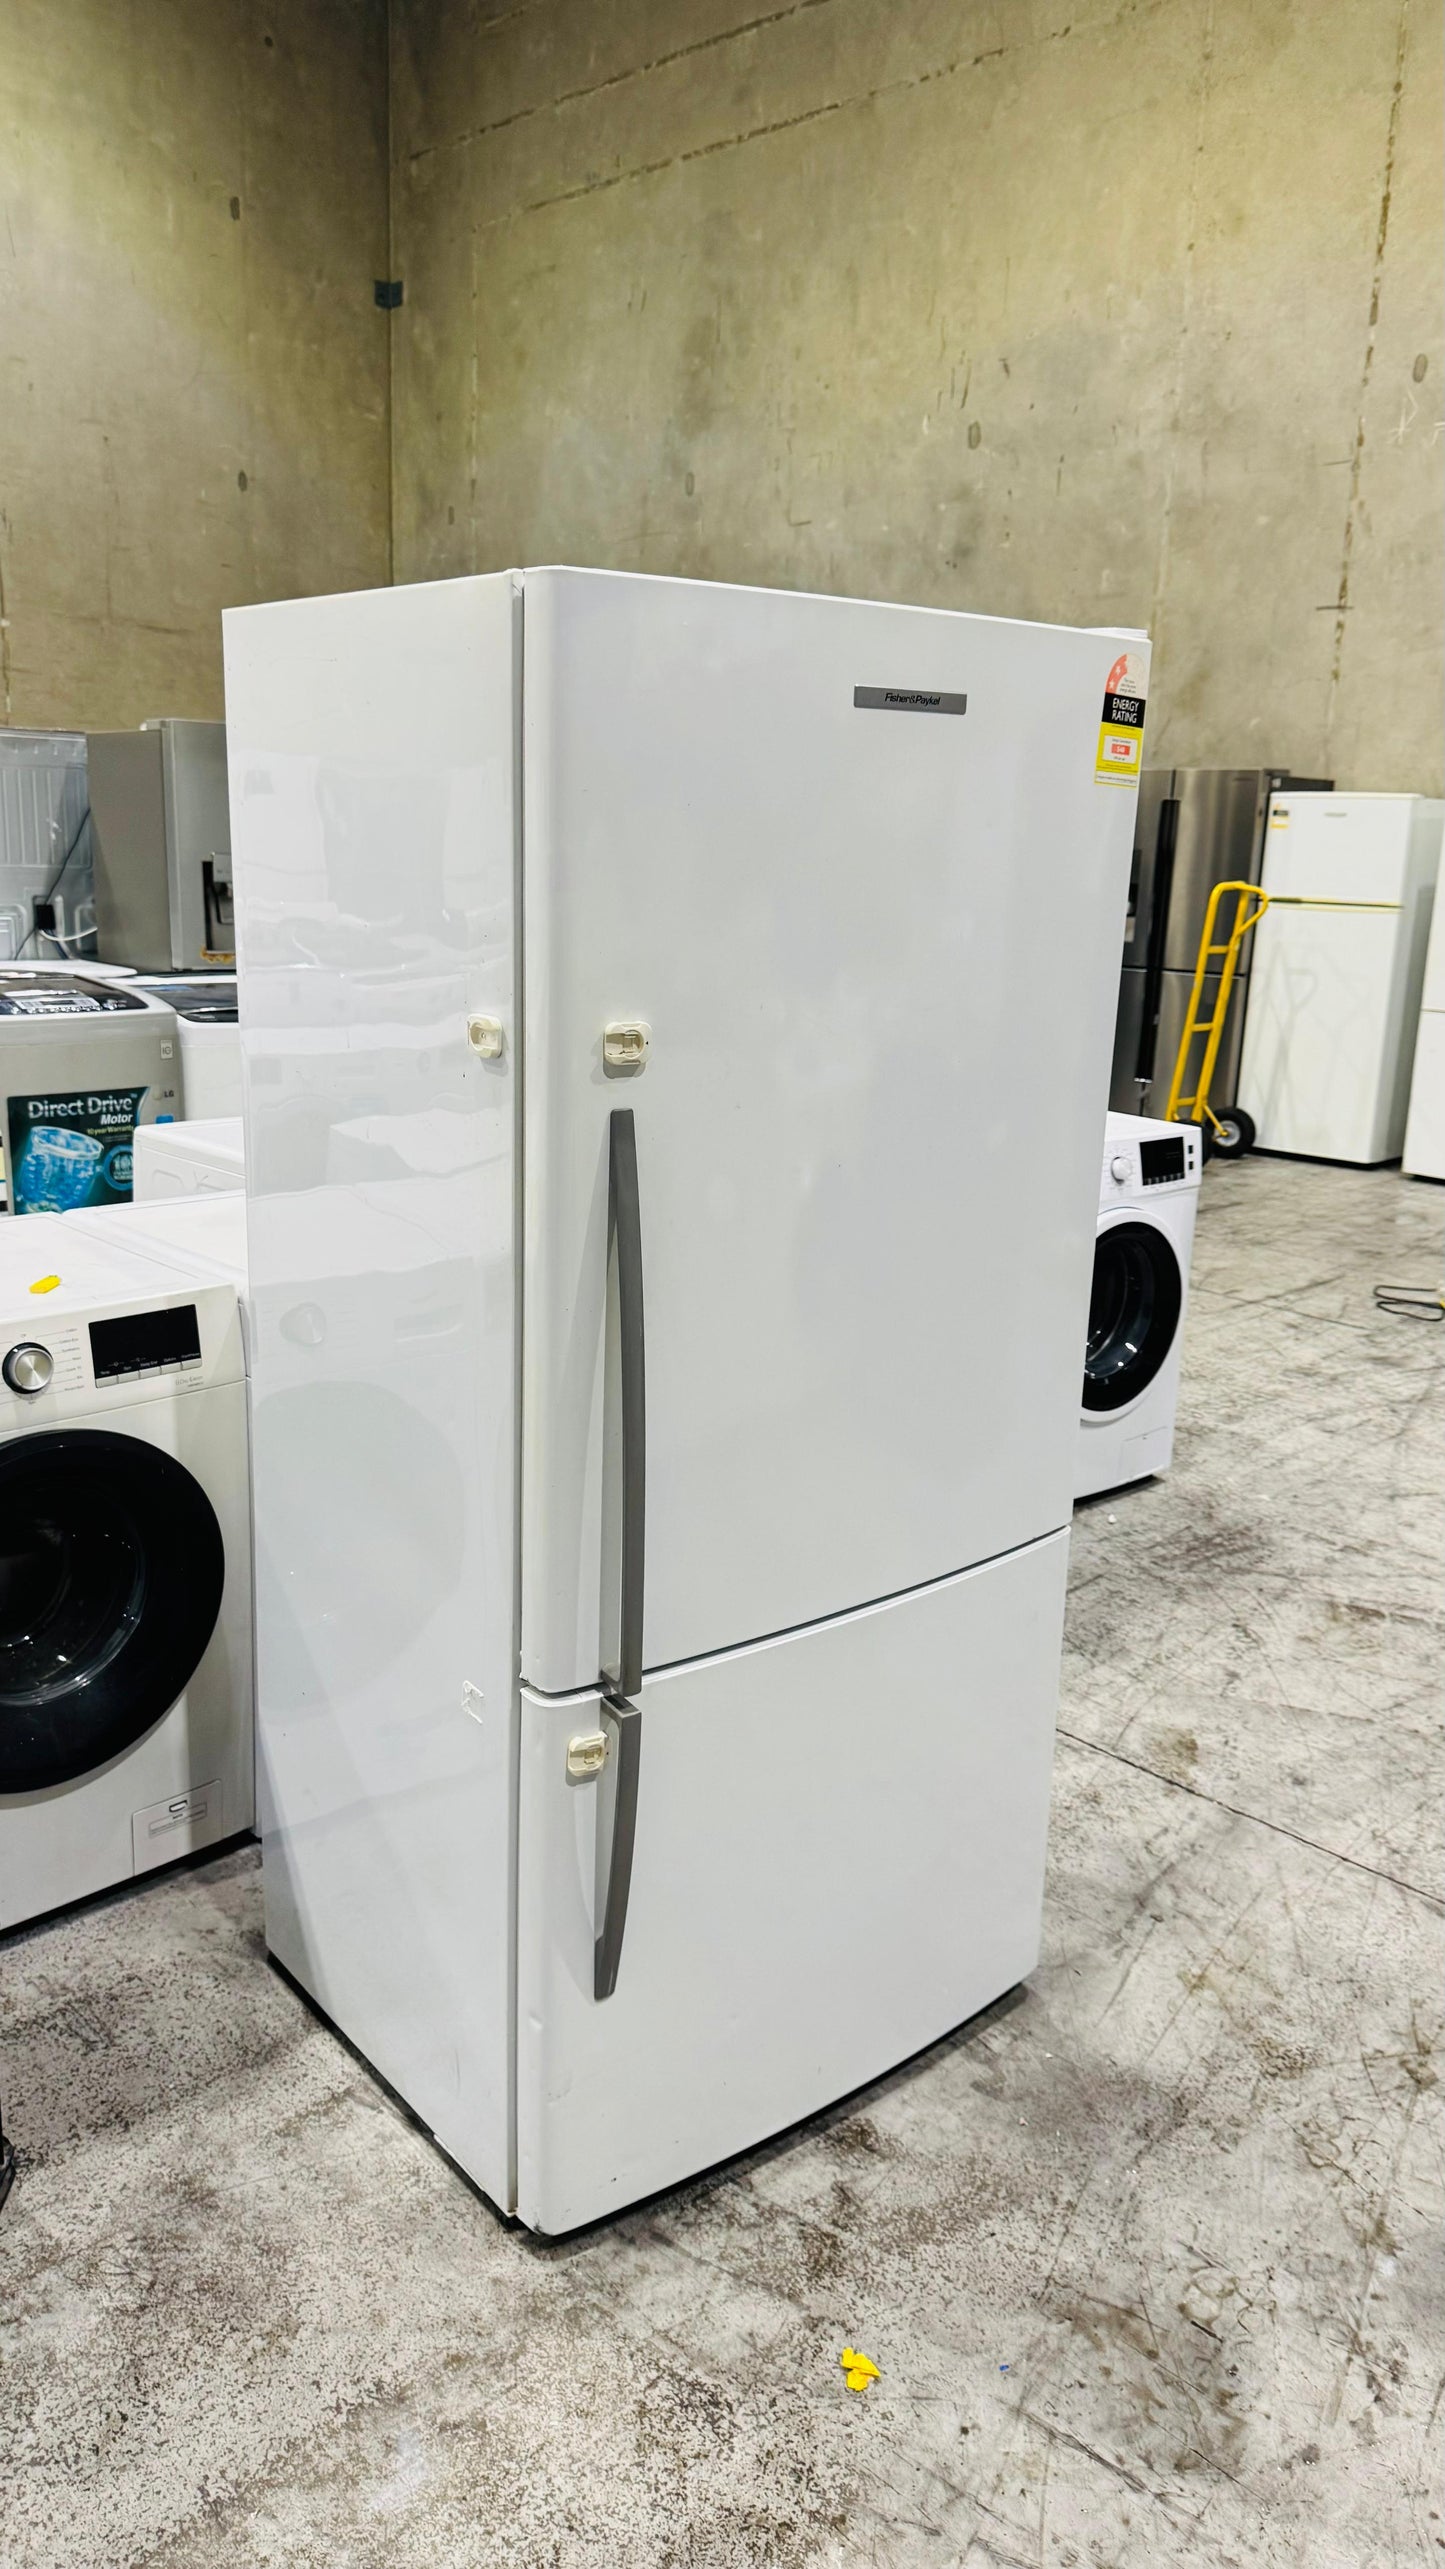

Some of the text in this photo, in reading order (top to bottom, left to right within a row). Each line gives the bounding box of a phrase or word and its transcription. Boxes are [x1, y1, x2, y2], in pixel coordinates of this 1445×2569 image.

[1112, 697, 1139, 712] ENERGY
[1112, 709, 1137, 724] RATING
[164, 1090, 175, 1099] LG
[28, 1101, 85, 1119] Direct
[100, 1113, 134, 1126] Motor
